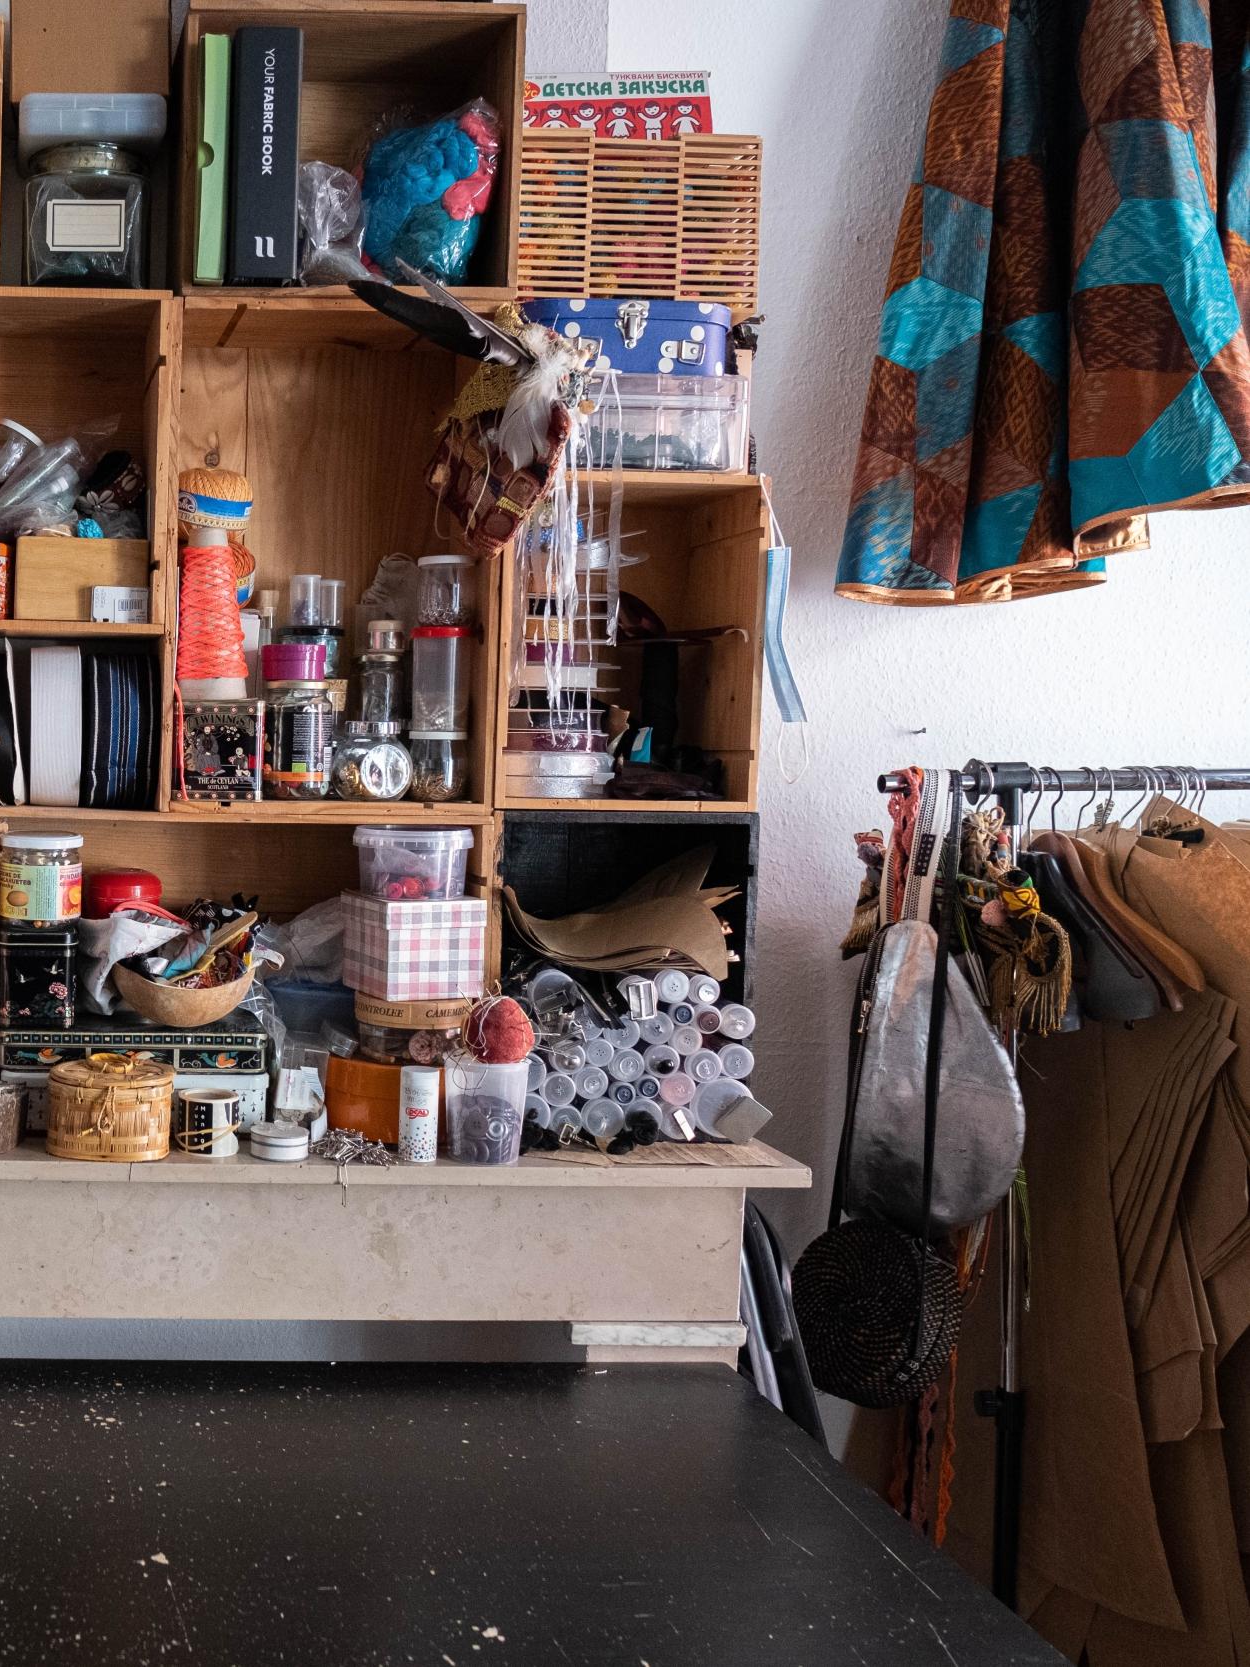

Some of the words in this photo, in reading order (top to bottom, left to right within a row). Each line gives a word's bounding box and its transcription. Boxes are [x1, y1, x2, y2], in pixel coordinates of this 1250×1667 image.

[264, 48, 275, 85] YOUR
[609, 72, 655, 81] ТУНКВАНИ
[542, 81, 612, 97] ДЕТСКА
[617, 79, 706, 95] ЗАКУСКА
[262, 86, 274, 133] FABRIC
[261, 136, 273, 176] BOOK
[194, 714, 245, 725] TWININGS
